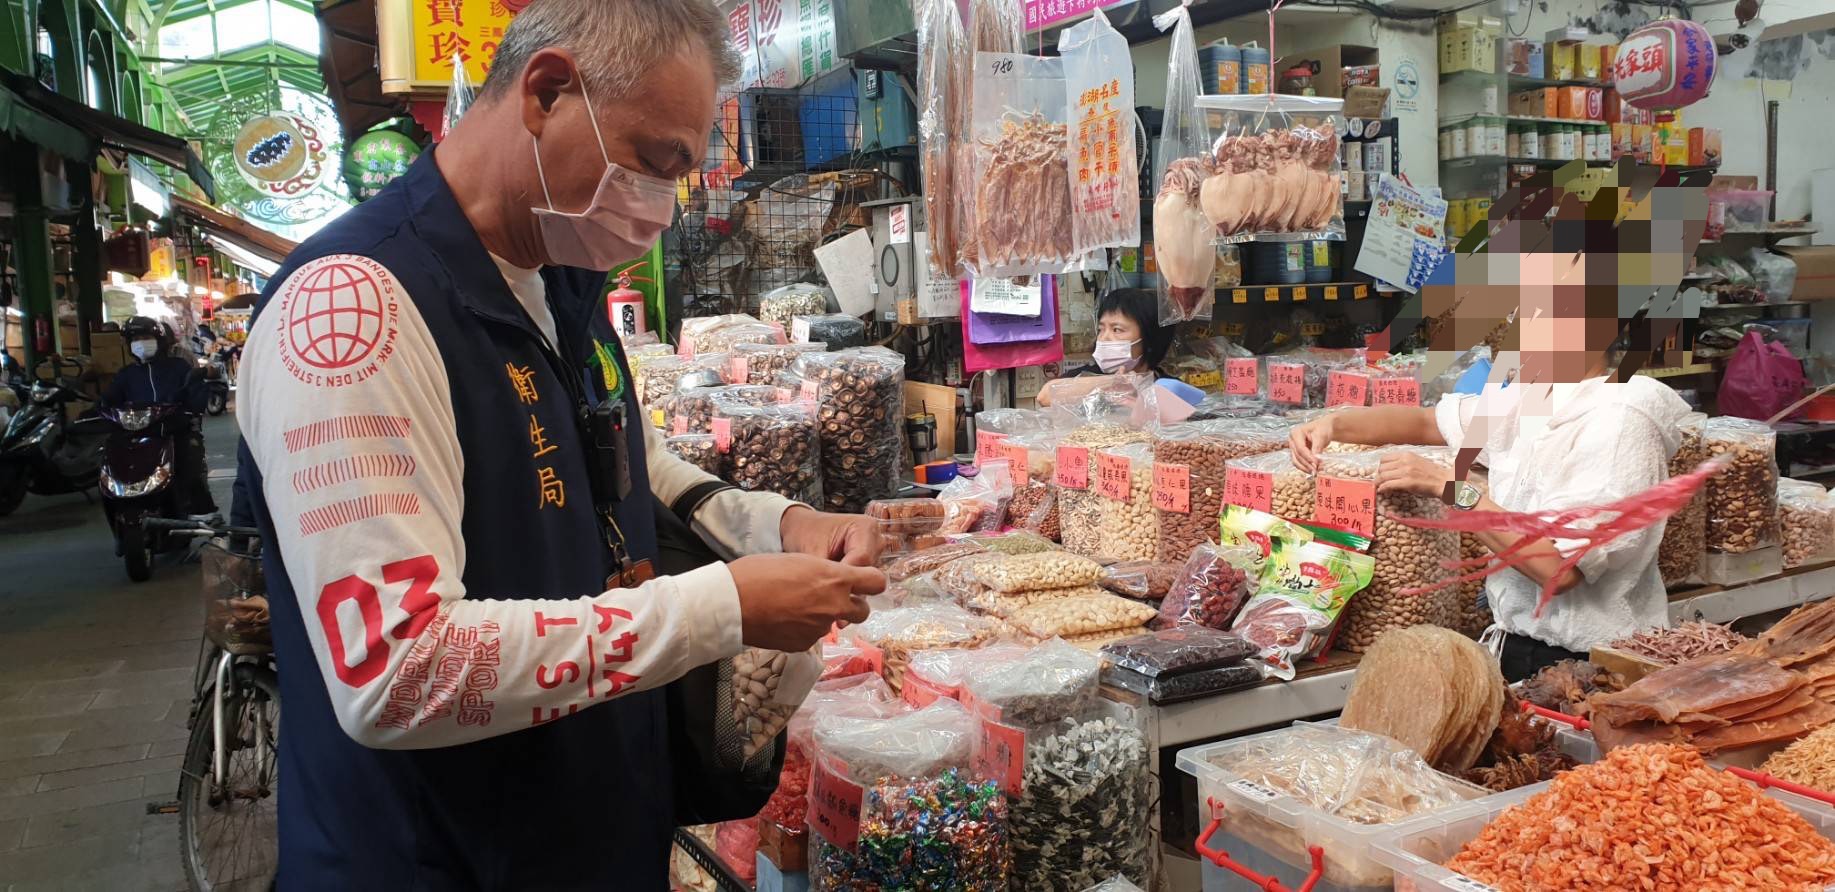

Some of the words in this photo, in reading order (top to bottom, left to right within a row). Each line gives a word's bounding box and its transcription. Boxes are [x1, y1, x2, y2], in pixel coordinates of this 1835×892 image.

[992, 59, 1013, 75] 980
[355, 255, 394, 294] BANDES
[388, 302, 398, 324] DIE
[326, 375, 352, 387] DEN
[357, 362, 378, 382] MIT
[505, 361, 566, 510] 衛生局
[1317, 492, 1372, 514] 原味開心果
[316, 554, 442, 688] 03
